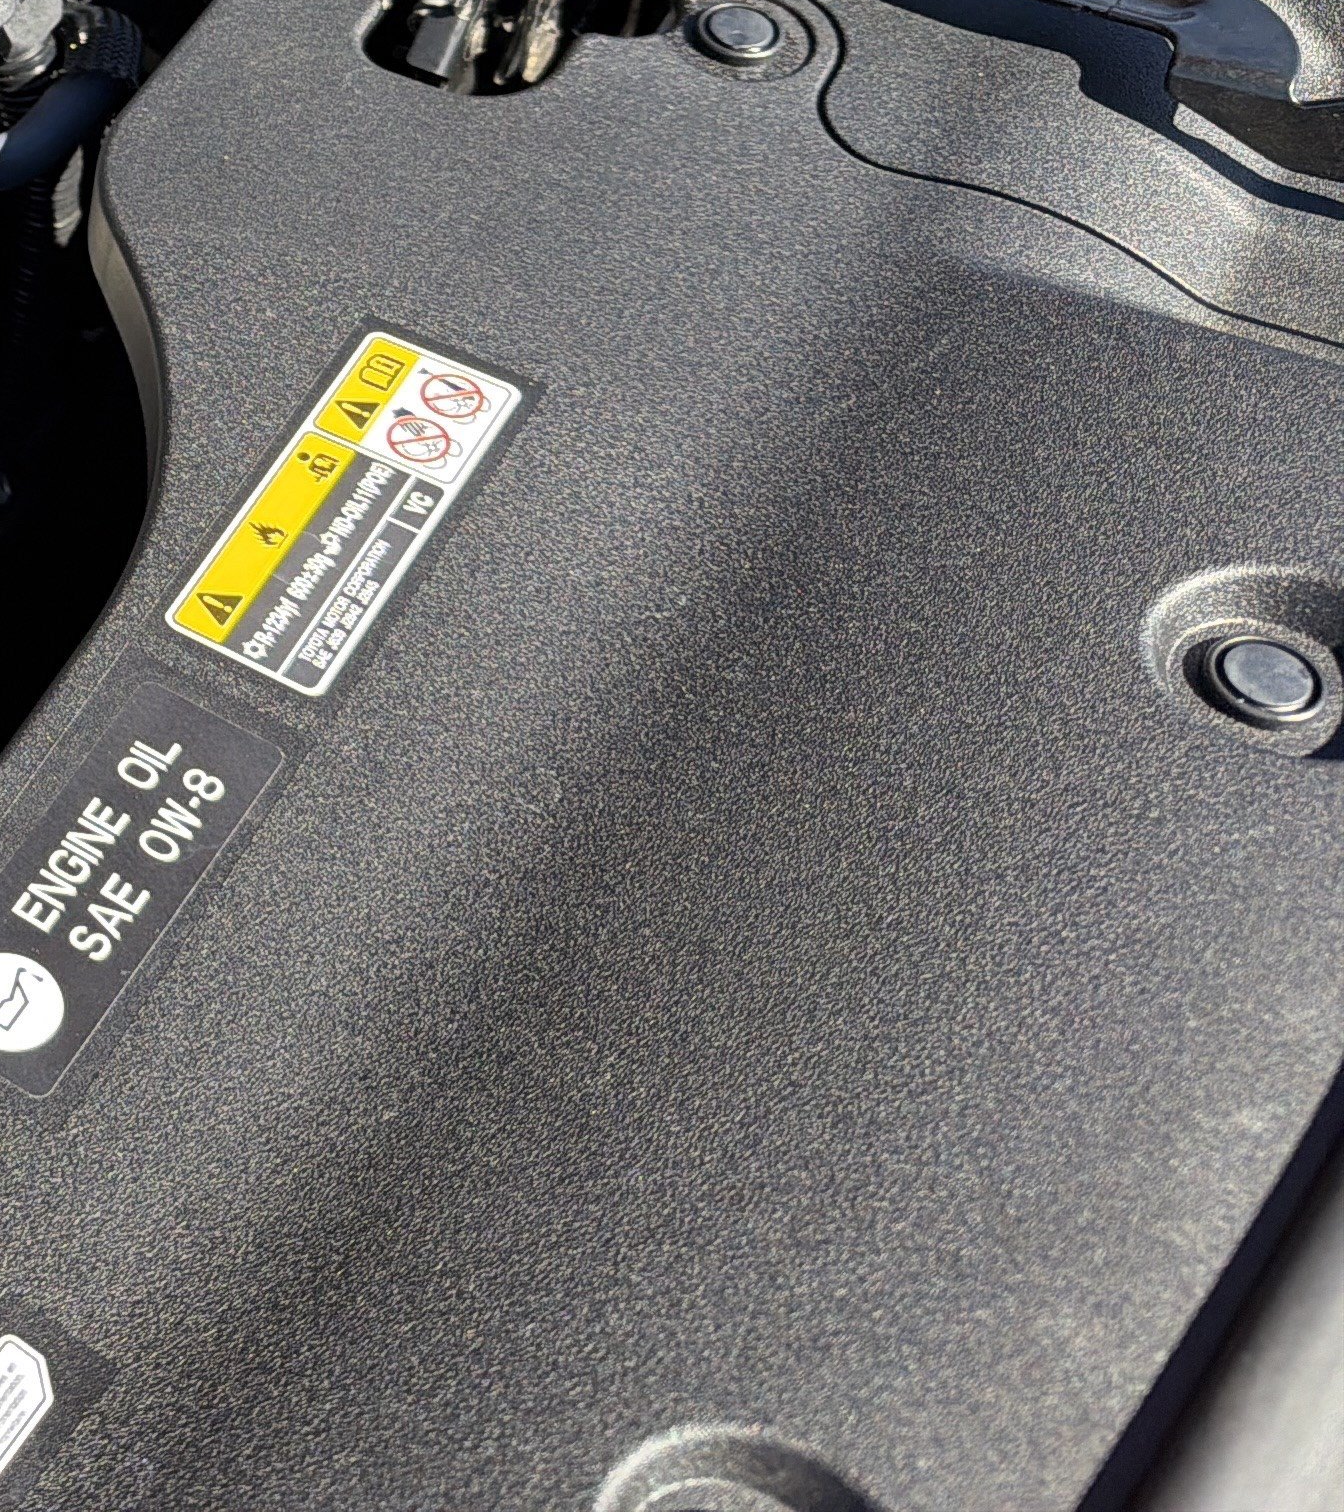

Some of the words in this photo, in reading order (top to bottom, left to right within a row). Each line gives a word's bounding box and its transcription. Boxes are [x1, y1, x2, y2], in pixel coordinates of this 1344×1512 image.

[403, 490, 436, 516] VC
[298, 627, 331, 662] TOYOTA
[321, 595, 352, 629] MOTOR
[343, 538, 392, 598] CORPORATION
[11, 797, 132, 935] ENGINE
[117, 740, 183, 792] OIL
[69, 872, 151, 962] SAE
